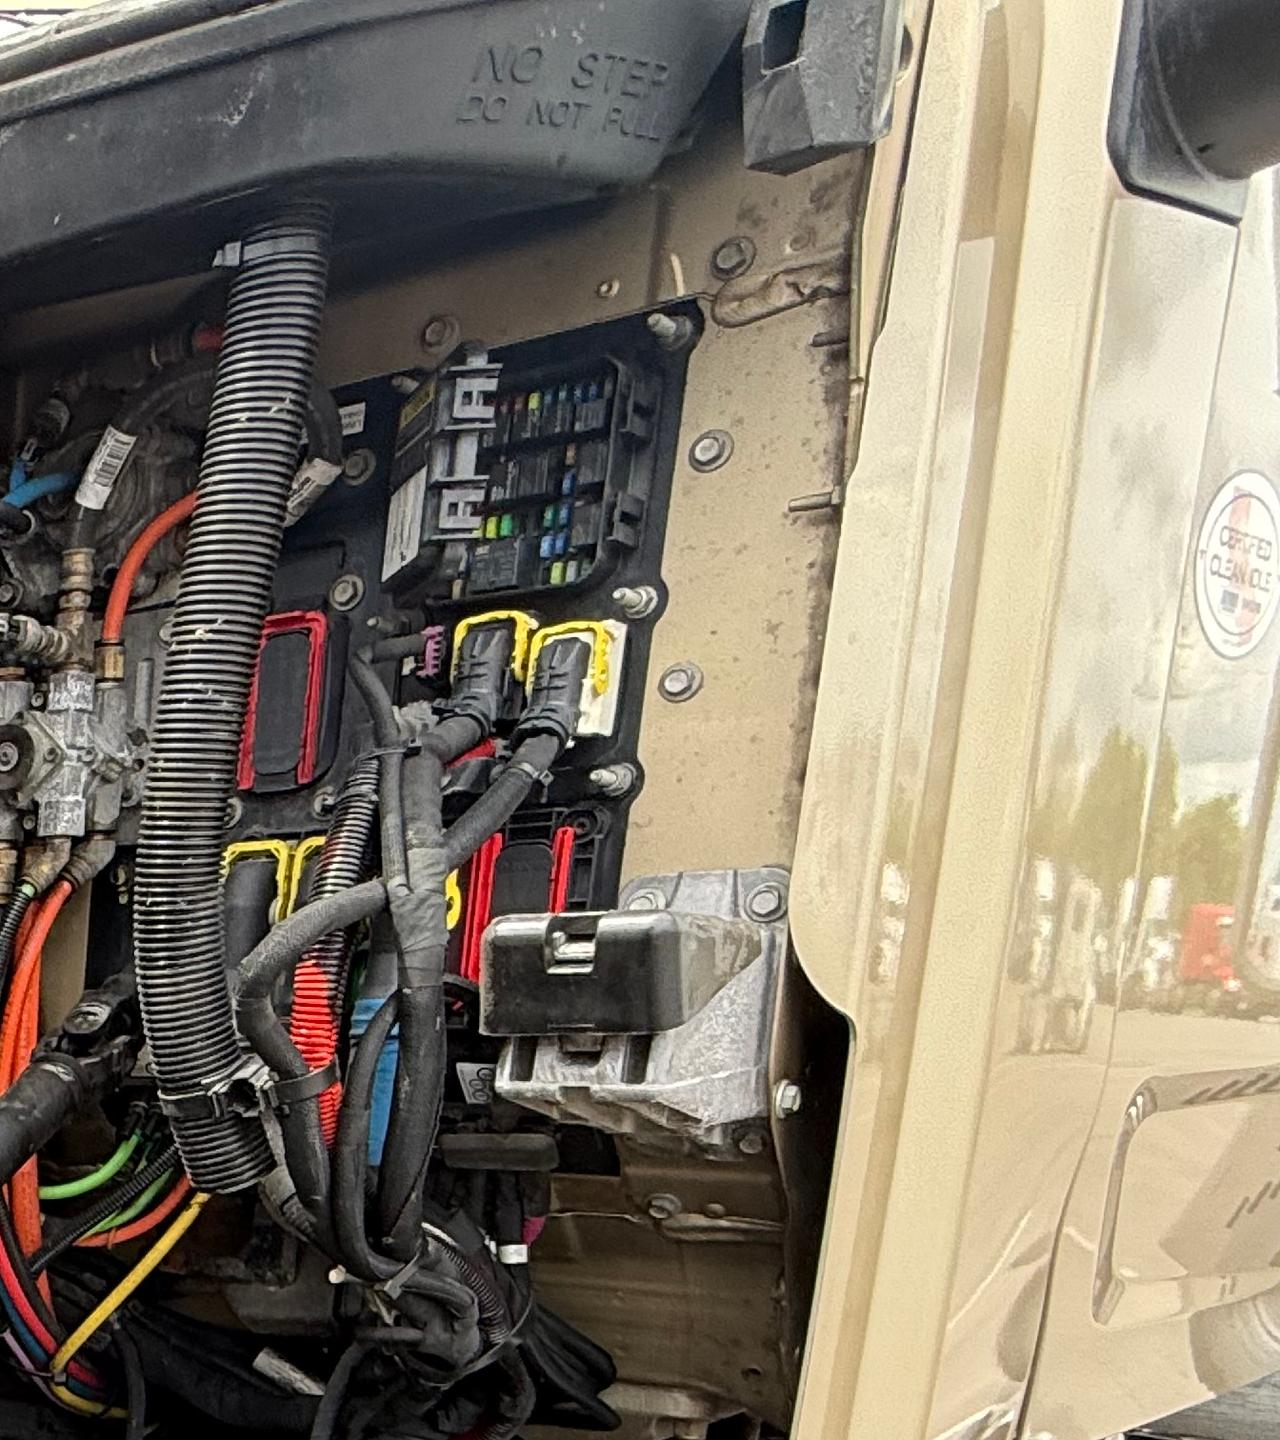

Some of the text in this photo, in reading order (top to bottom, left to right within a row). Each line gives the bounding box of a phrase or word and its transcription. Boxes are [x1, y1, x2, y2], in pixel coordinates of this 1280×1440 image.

[471, 44, 668, 99] NO STEP
[456, 96, 506, 125] DO
[526, 100, 592, 130] NOT
